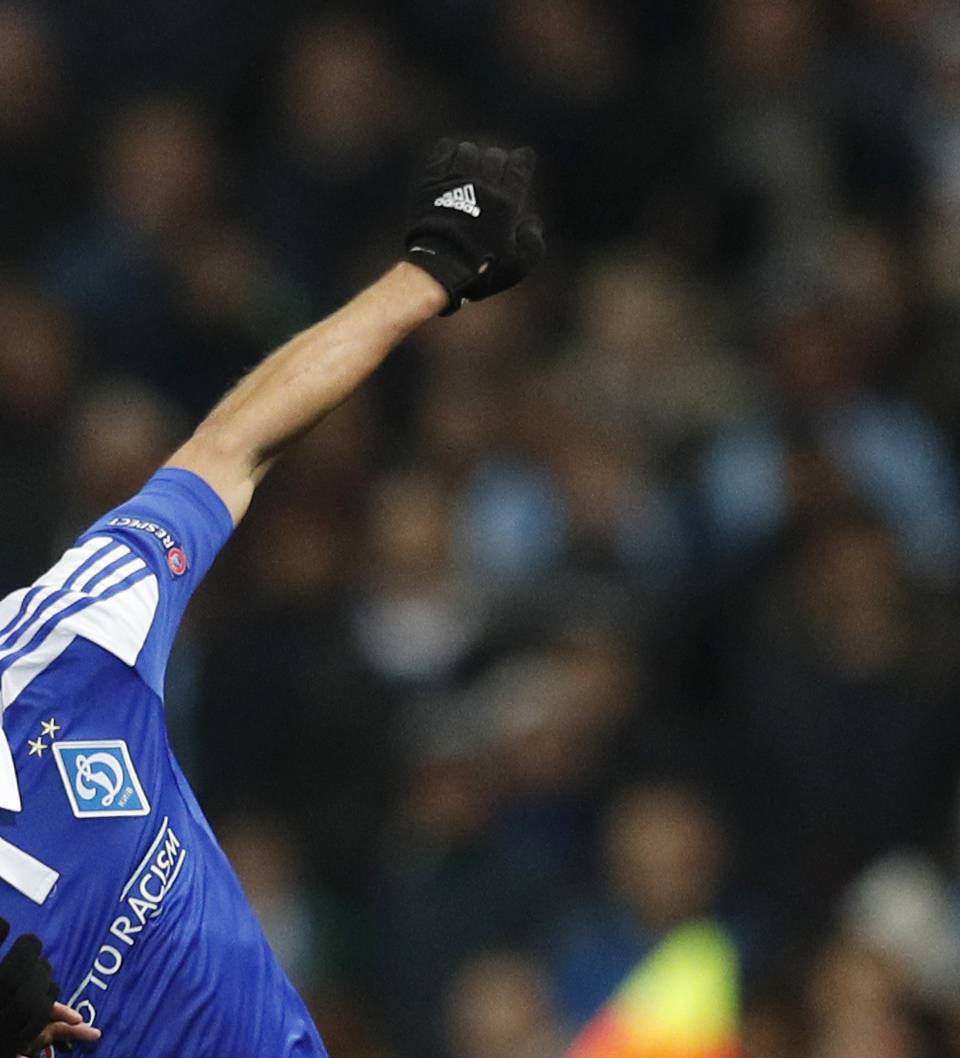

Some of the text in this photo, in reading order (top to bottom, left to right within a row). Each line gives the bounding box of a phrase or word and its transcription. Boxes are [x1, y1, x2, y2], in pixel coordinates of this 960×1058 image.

[107, 518, 175, 549] RESPECT
[90, 945, 123, 990] TO
[109, 828, 180, 946] RACISM
